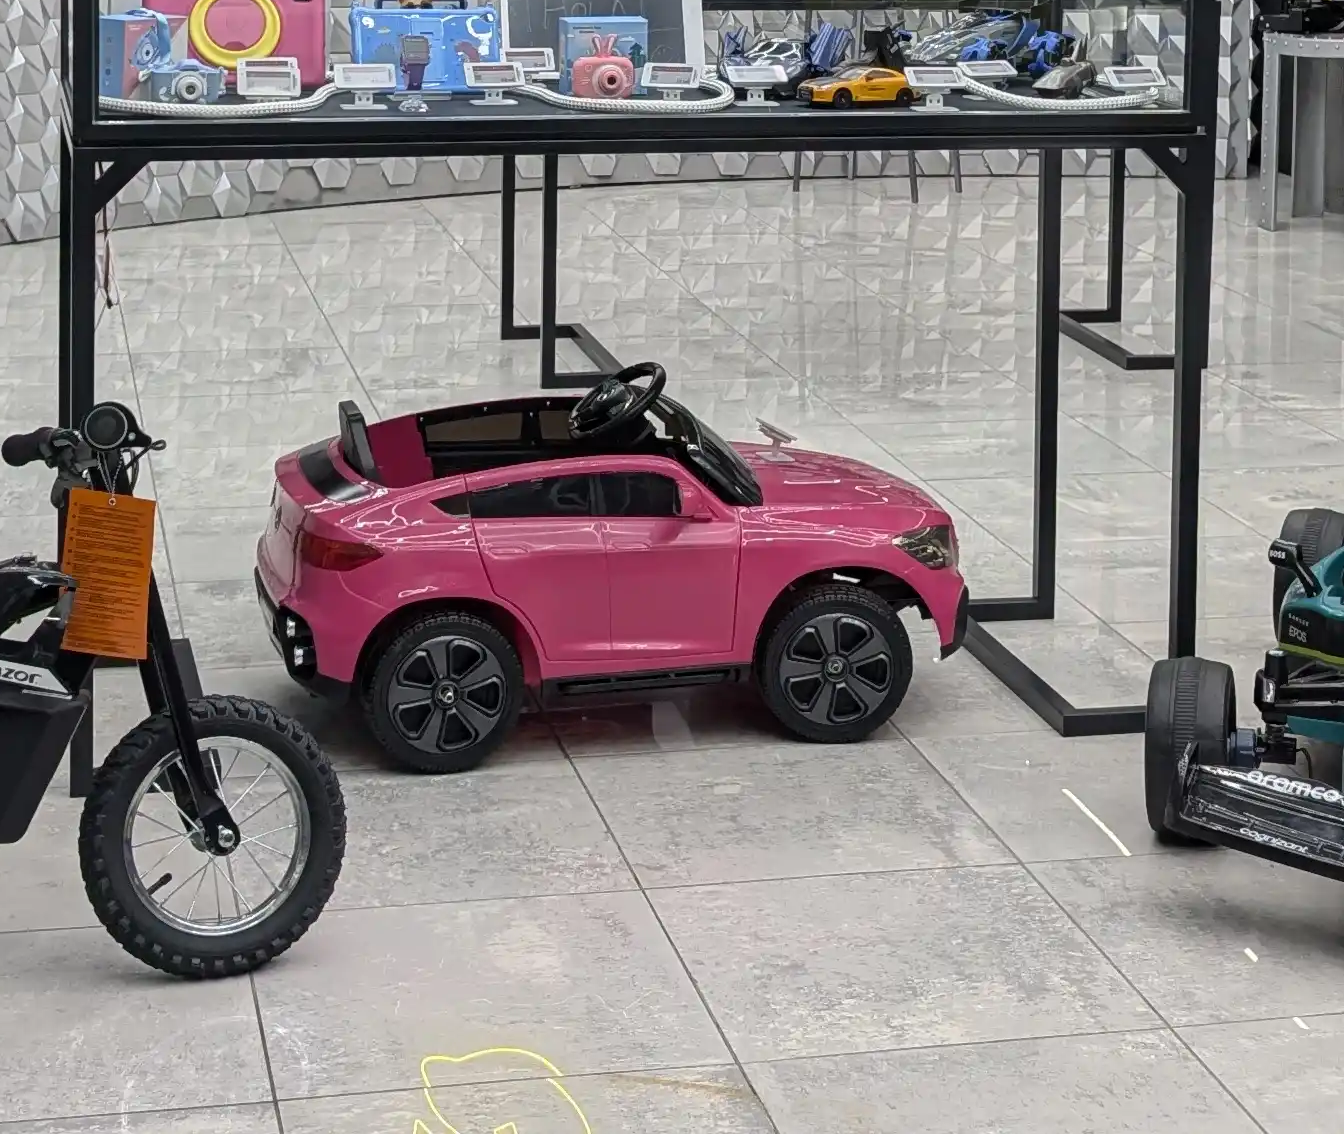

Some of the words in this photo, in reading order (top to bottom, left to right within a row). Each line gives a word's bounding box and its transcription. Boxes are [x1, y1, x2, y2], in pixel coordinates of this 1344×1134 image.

[1288, 625, 1307, 643] EPOS
[1247, 769, 1343, 803] aramco
[1239, 826, 1308, 854] cognizant
